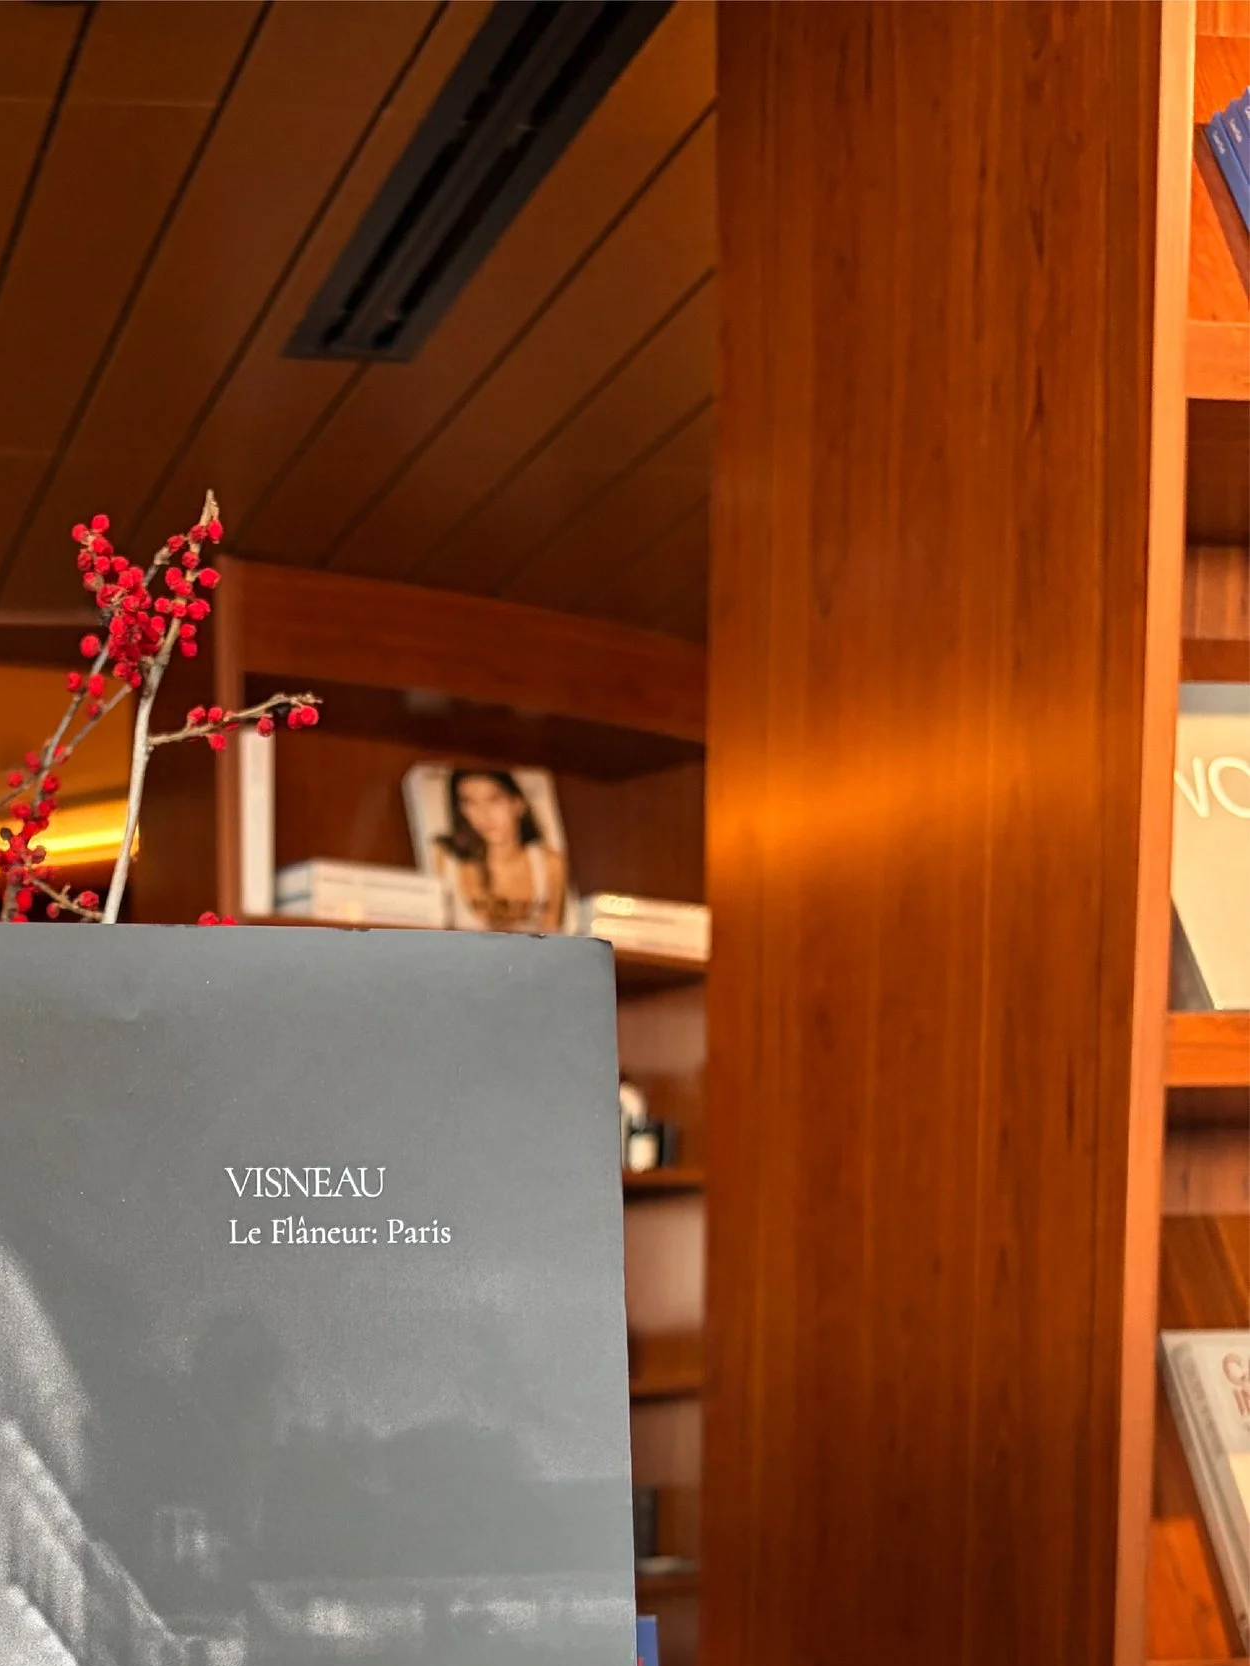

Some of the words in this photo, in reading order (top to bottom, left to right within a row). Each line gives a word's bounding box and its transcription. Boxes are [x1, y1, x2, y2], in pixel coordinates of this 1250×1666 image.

[225, 1166, 385, 1198] VISNEAU
[229, 1219, 261, 1245] Le
[271, 1215, 377, 1245] Flâneur:
[387, 1218, 451, 1245] Paris
